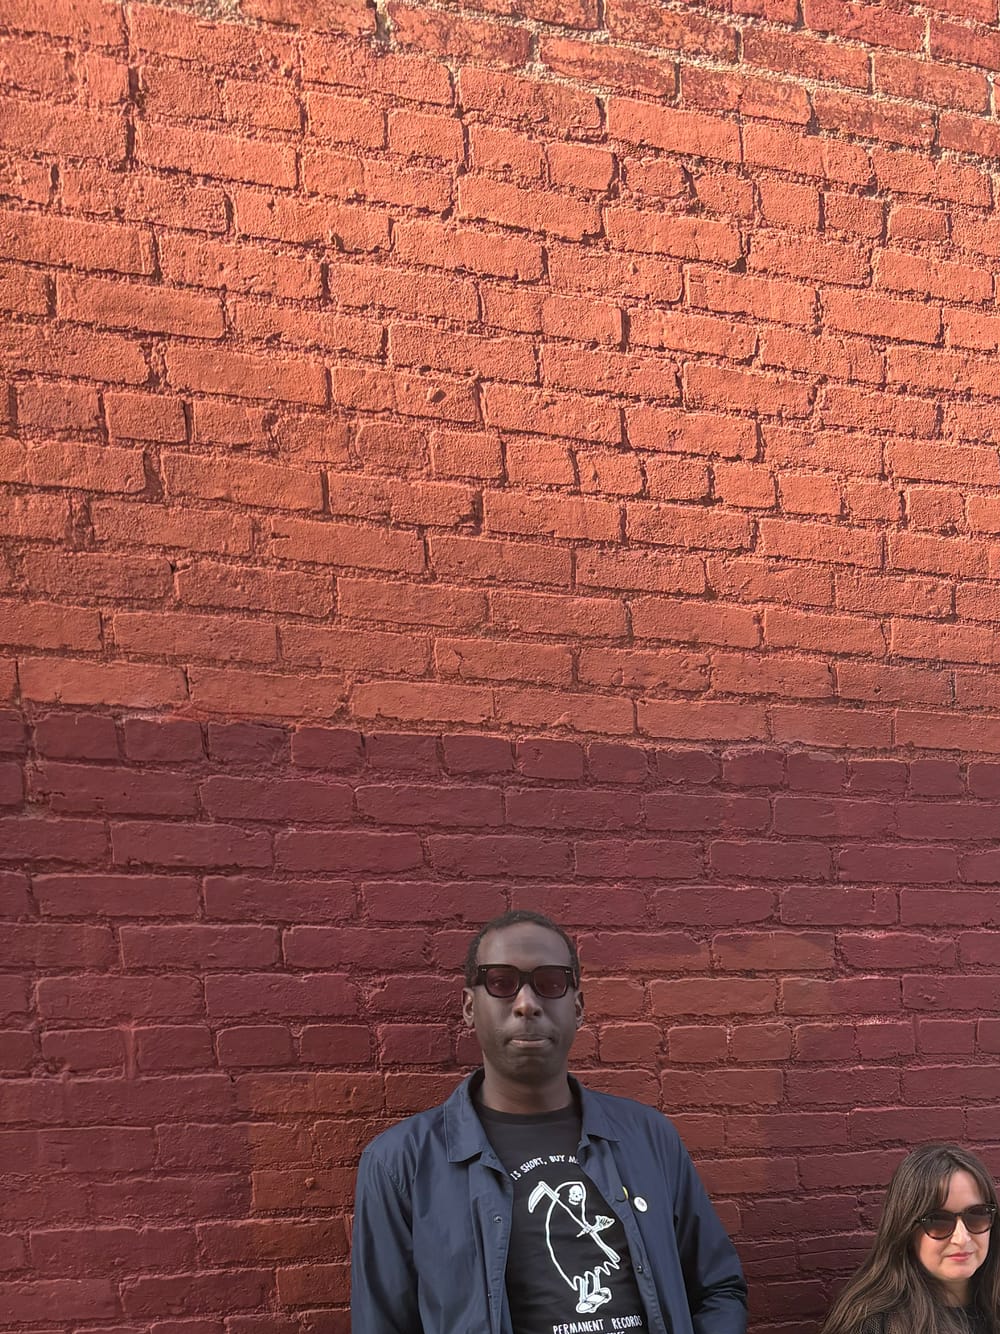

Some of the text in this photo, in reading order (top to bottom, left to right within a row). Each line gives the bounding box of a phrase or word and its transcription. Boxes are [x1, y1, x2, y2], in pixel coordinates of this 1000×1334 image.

[510, 1170, 522, 1180] IS
[549, 1154, 565, 1162] BUY
[611, 1315, 642, 1330] RECORDS
